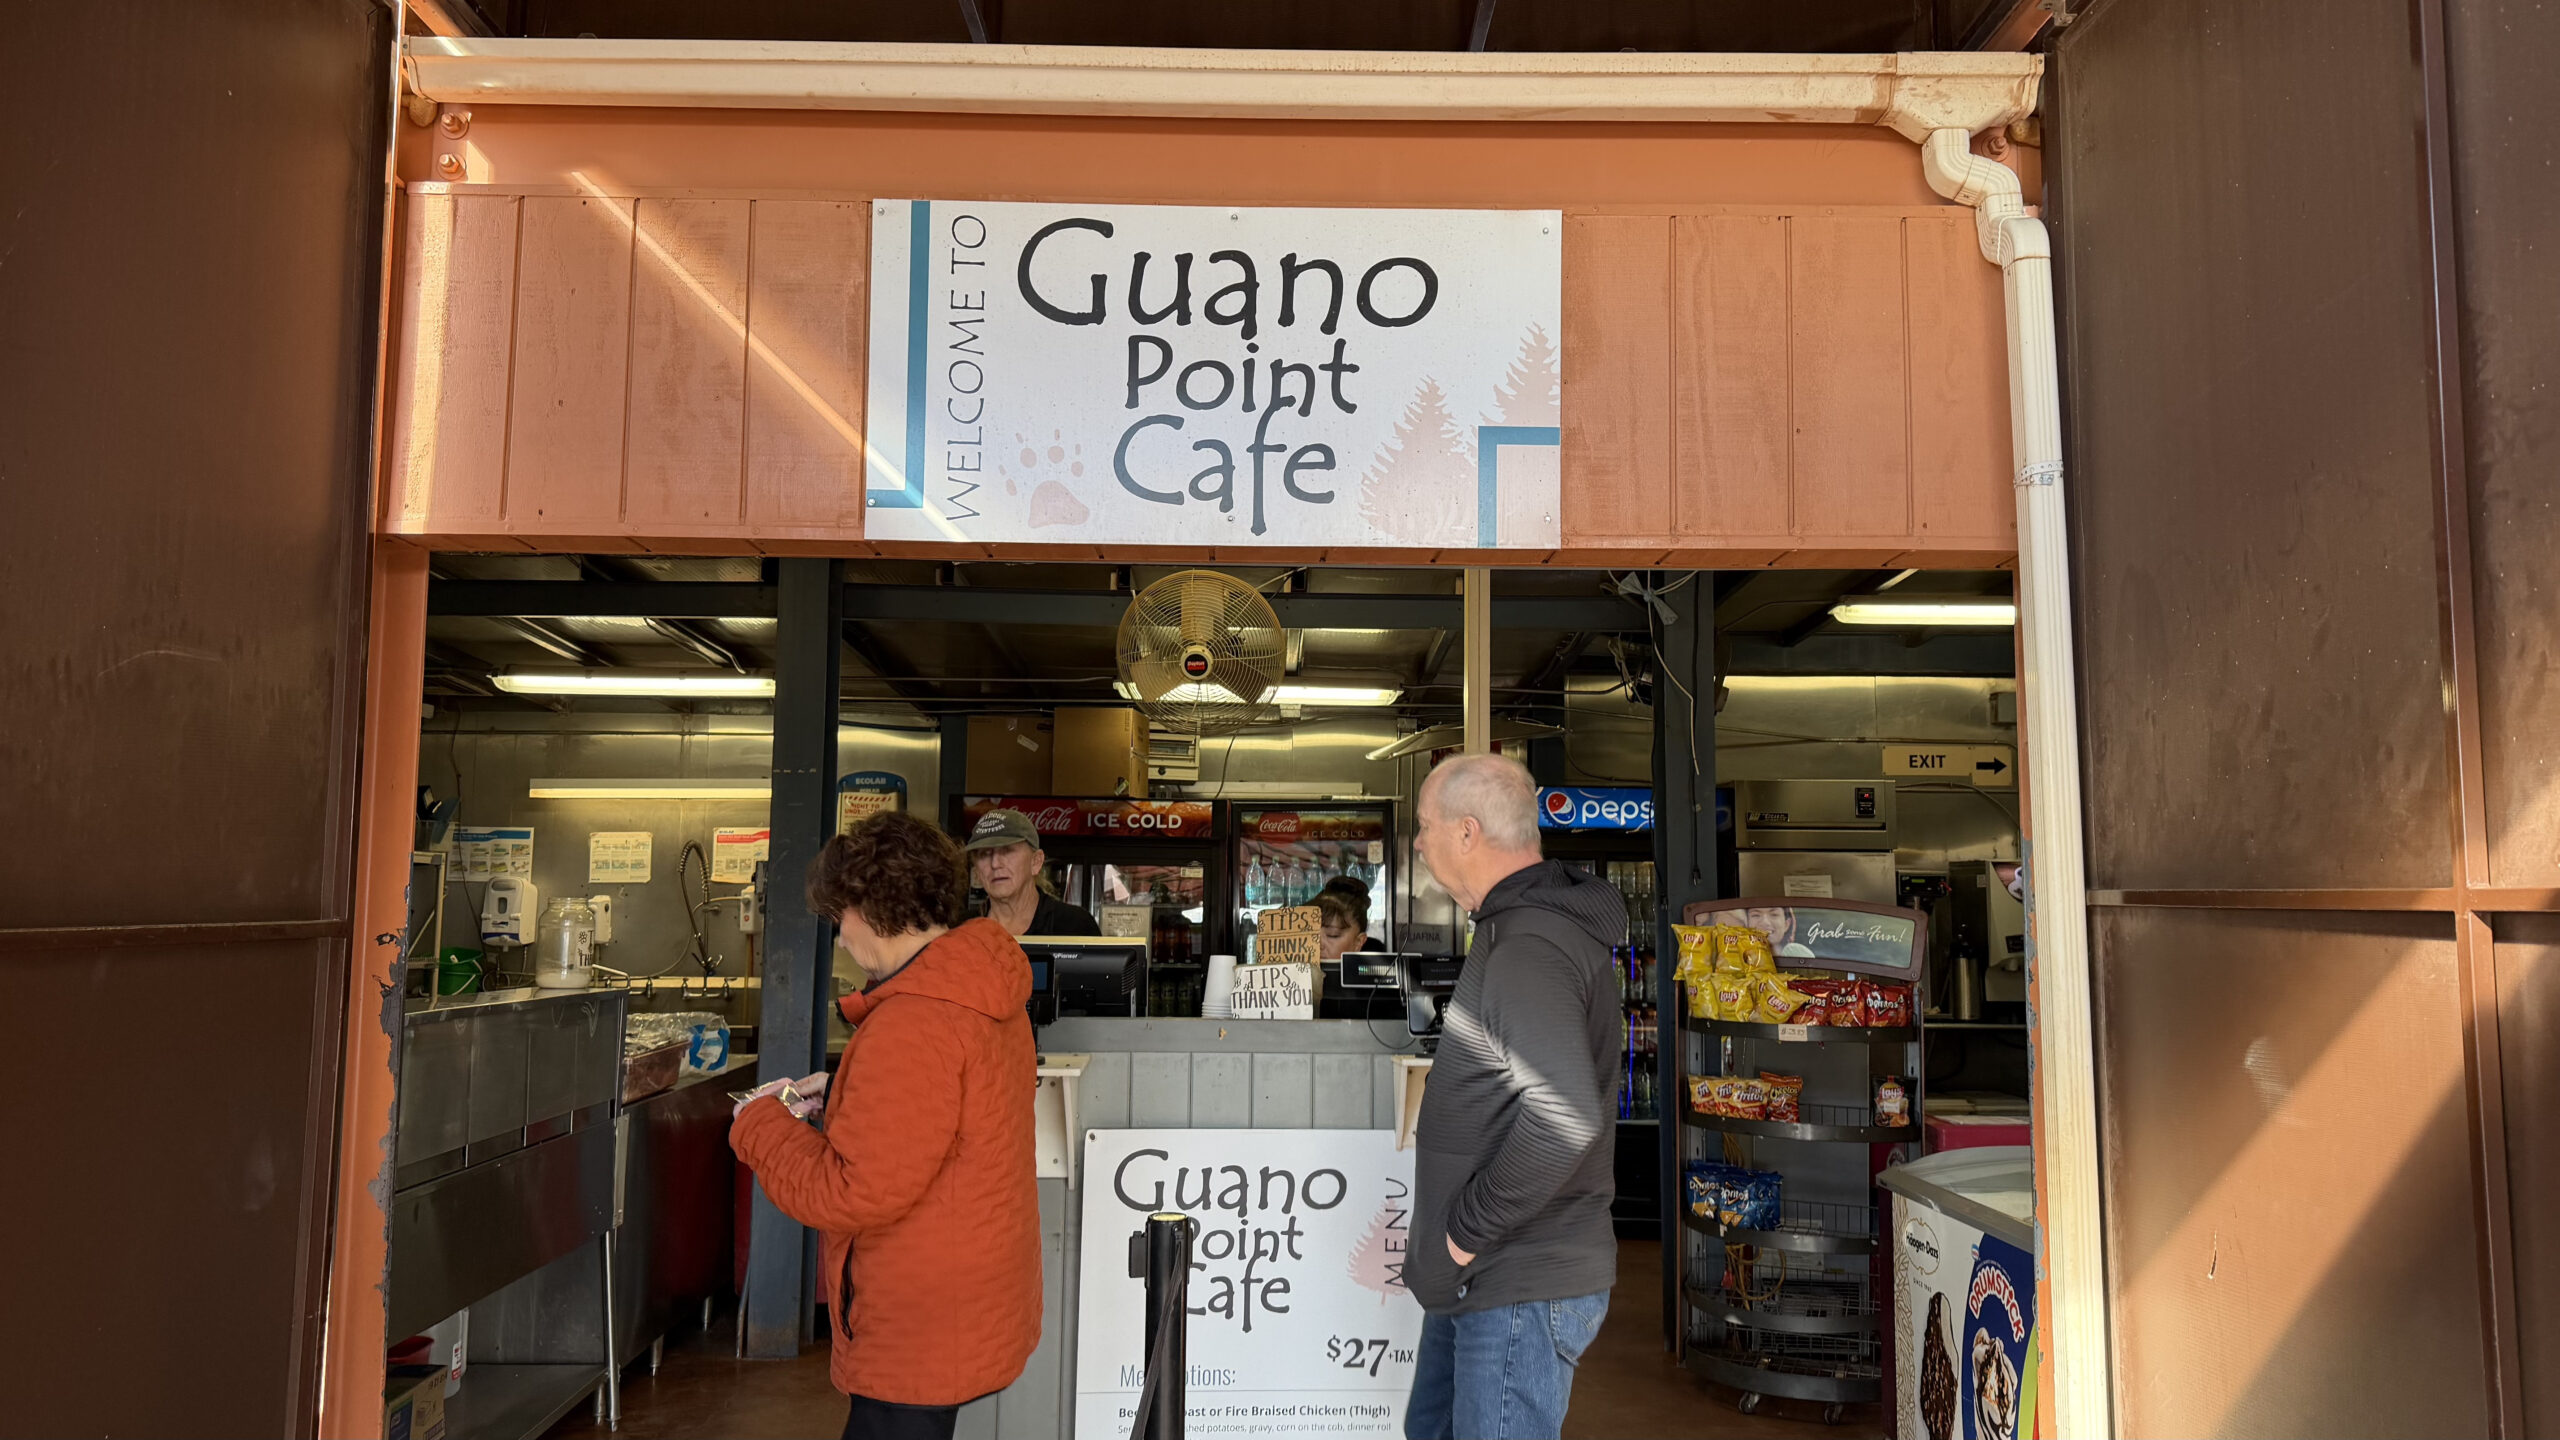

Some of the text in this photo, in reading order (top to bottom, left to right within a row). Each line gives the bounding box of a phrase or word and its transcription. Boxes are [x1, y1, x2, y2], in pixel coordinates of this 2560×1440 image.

[1017, 217, 1439, 339] Guano
[945, 213, 987, 522] WELCOME TO
[1124, 335, 1360, 415] Point
[1112, 395, 1337, 536] Cafe
[1908, 753, 1947, 770] EXIT
[1087, 813, 1123, 829] ICE
[1127, 814, 1182, 830] COLD
[1581, 799, 1655, 826] peps
[1306, 830, 1365, 838] ICE COLD
[1265, 912, 1309, 931] TIPS
[1807, 921, 1844, 945] Grab
[1866, 924, 1907, 943] Fun!
[1260, 937, 1309, 955] THANK
[1245, 966, 1291, 990] TIPS
[1230, 989, 1313, 1009] THANK YOU
[1114, 1148, 1347, 1218] Guano
[1384, 1177, 1409, 1288] MENU
[1969, 1267, 2024, 1341] DRUMSTICK
[1326, 1334, 1390, 1377] $27
[1119, 1364, 1237, 1388] Me tions:
[1210, 1406, 1223, 1417] or
[1225, 1405, 1248, 1417] Fire
[1251, 1405, 1296, 1416] Braised
[1299, 1404, 1346, 1416] Chicken
[1349, 1405, 1391, 1418] (Thigh)
[1207, 1423, 1248, 1434] potatoes,
[1311, 1422, 1325, 1431] the
[1327, 1422, 1345, 1432] cob,
[1347, 1422, 1375, 1431] dinner
[1377, 1421, 1391, 1431] roll
